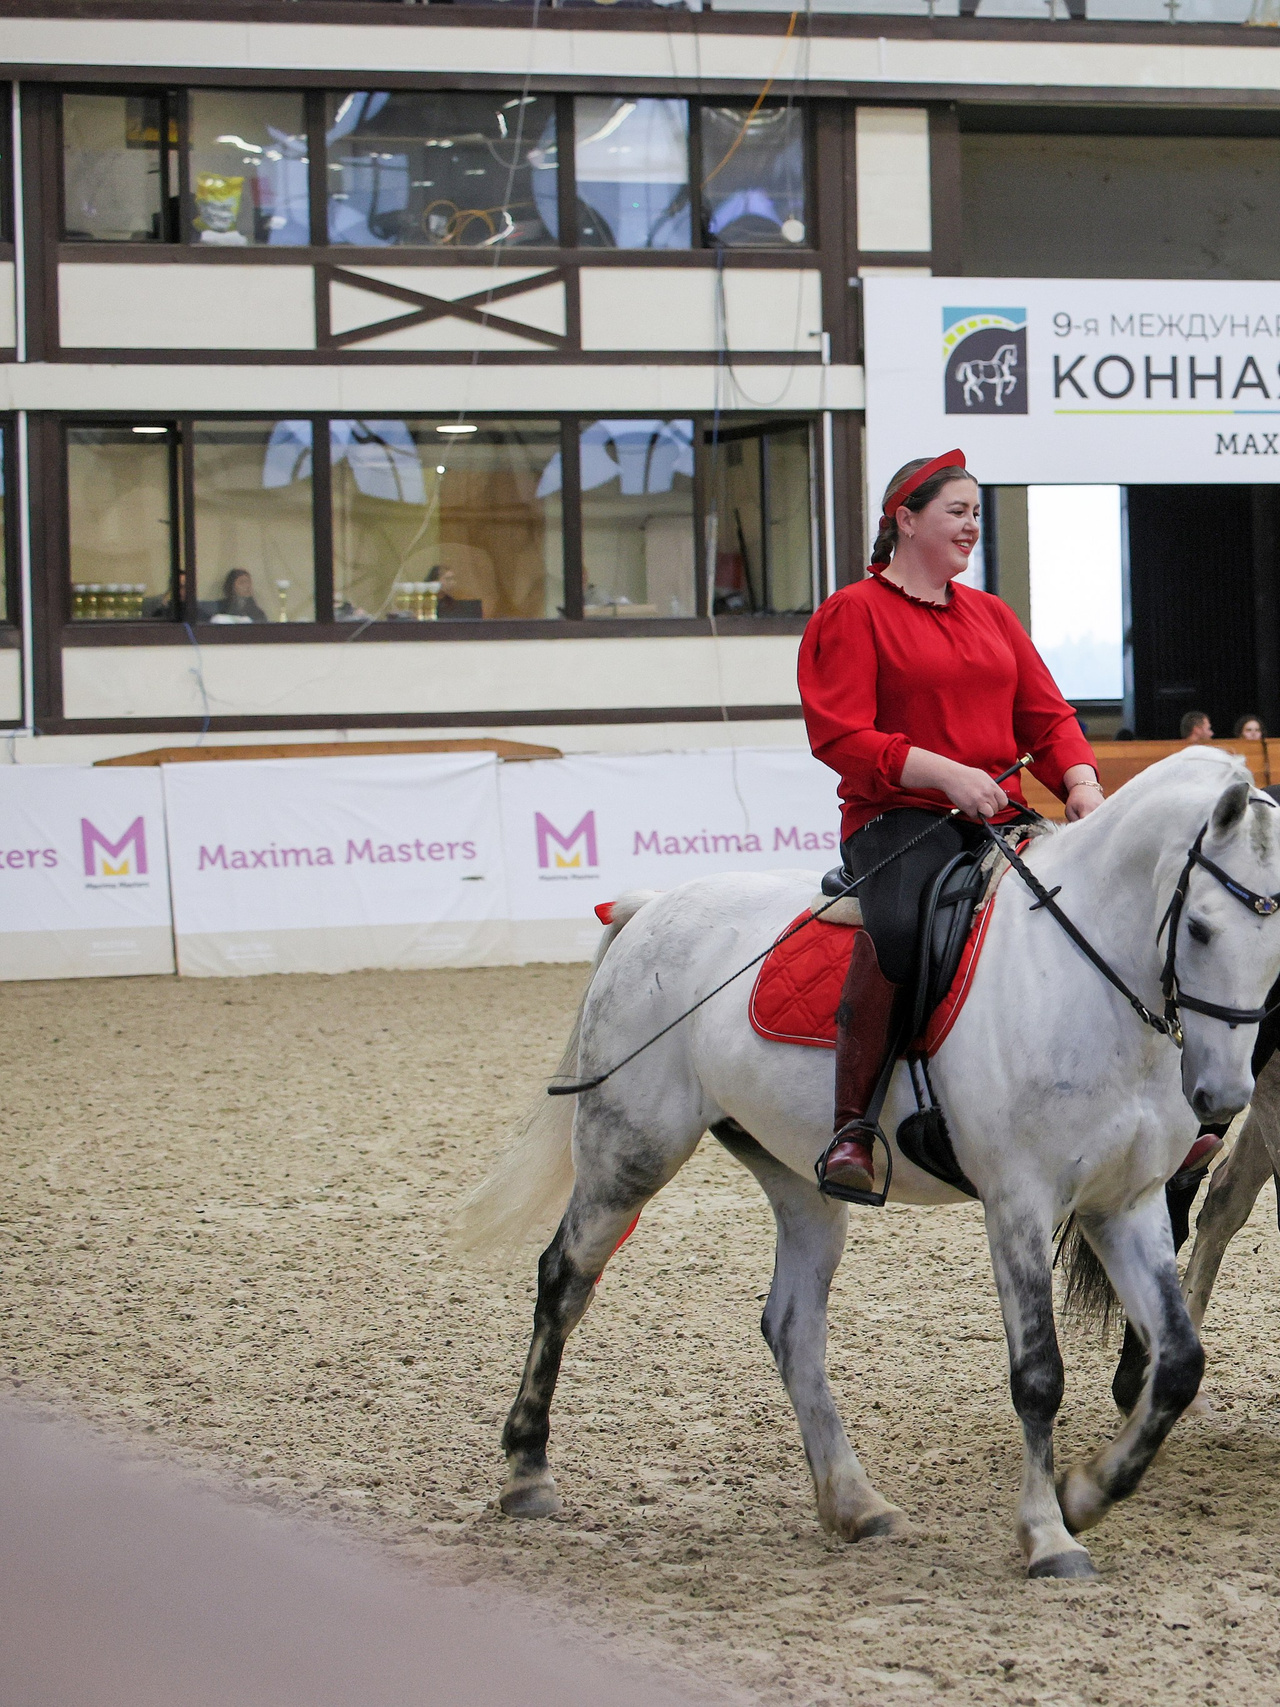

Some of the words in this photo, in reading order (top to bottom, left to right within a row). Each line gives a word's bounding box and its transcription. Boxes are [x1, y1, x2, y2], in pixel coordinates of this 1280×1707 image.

[1053, 311, 1099, 337] 9-я
[198, 845, 334, 870] Maxima
[346, 837, 477, 865] Masters
[633, 829, 763, 855] Maxima
[773, 826, 841, 851] Mas
